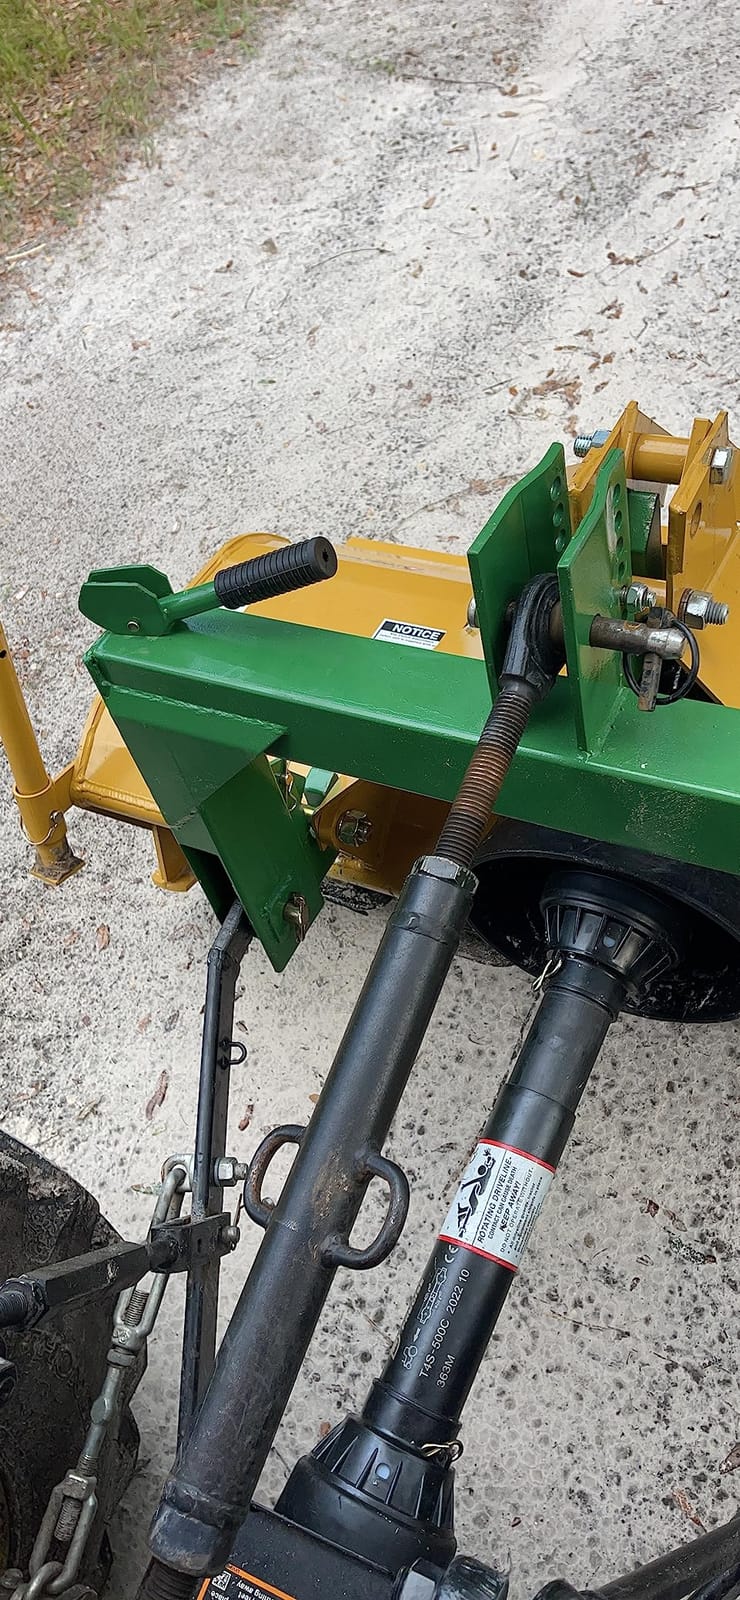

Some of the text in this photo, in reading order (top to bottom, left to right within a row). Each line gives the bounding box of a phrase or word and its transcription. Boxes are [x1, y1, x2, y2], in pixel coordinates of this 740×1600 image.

[392, 624, 441, 640] NOTICE
[476, 1202, 496, 1243] ROTATING
[488, 1214, 500, 1239] CONTACT
[501, 1184, 511, 1202] CAUSE
[508, 1166, 518, 1184] DEATH
[499, 1180, 521, 1232] KEEP AWAY!
[419, 1318, 450, 1378] T4S-500C
[447, 1285, 464, 1315] 2022
[458, 1268, 470, 1283] 10
[436, 1354, 456, 1388] 363M
